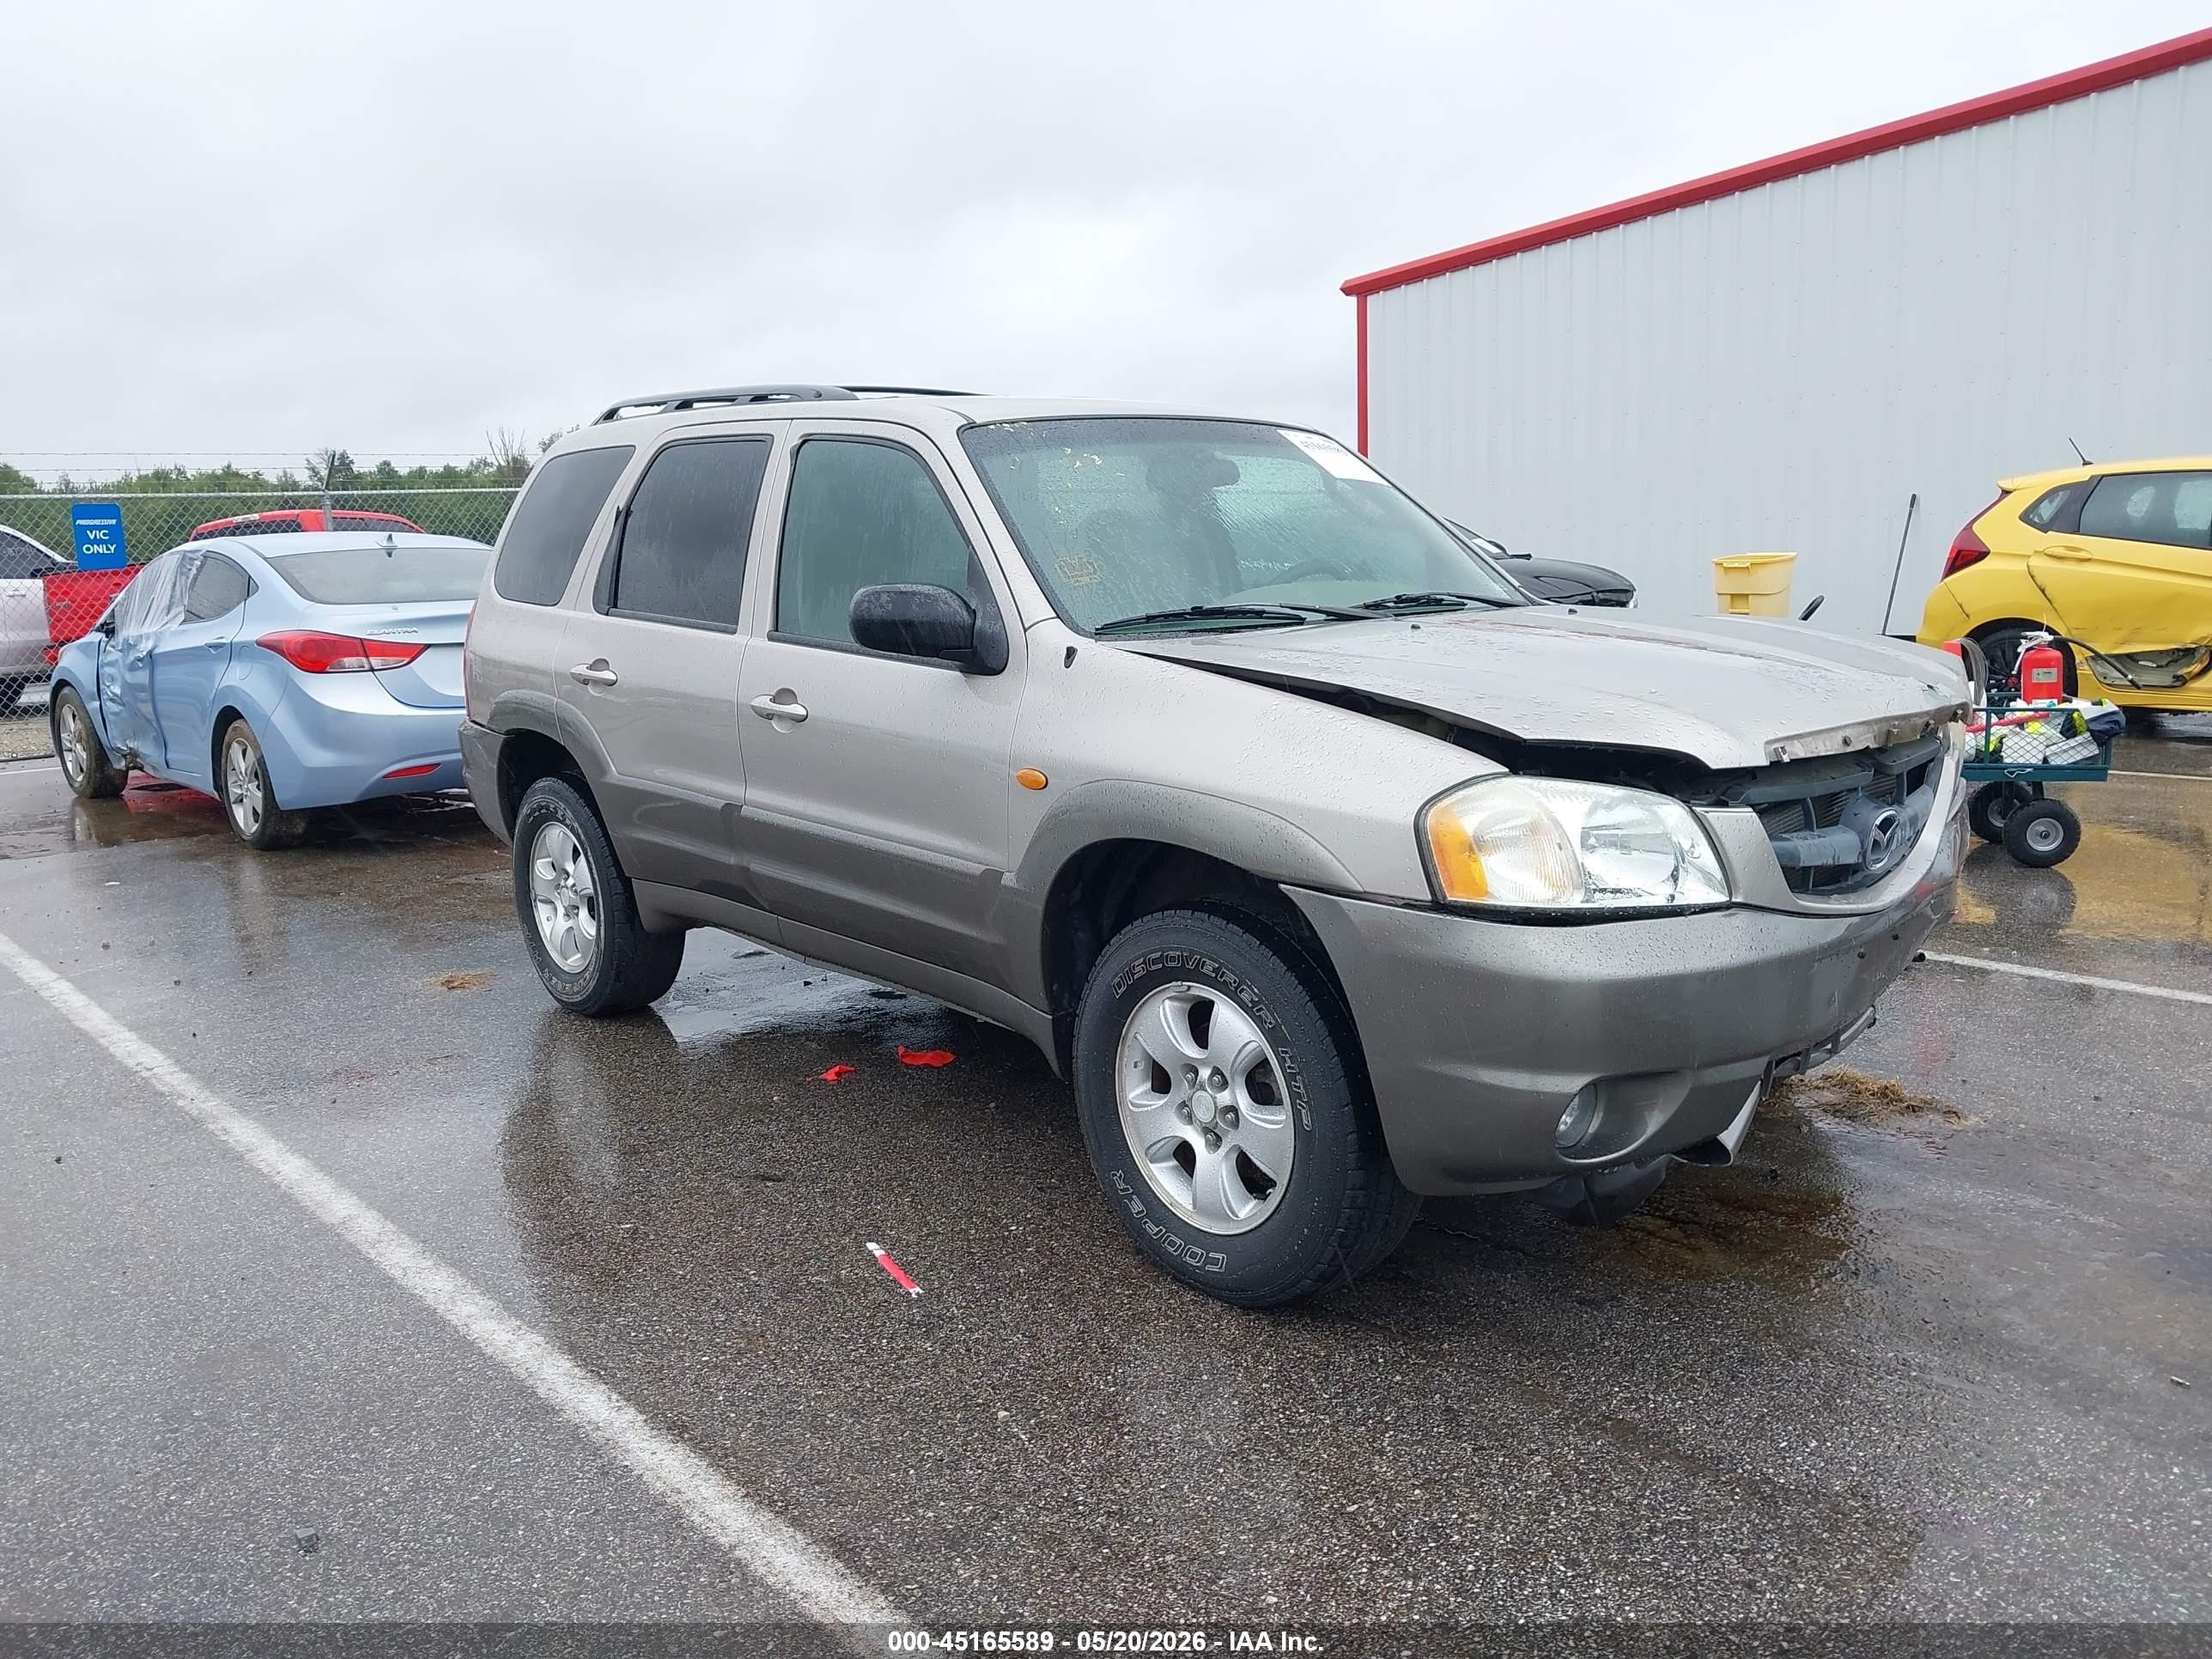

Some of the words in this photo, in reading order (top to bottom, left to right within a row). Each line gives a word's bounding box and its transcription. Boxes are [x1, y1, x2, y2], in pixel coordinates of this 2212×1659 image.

[82, 544, 117, 554] ONLY
[86, 529, 110, 540] VIC
[1111, 950, 1275, 1029] DISCOVERER
[1110, 1170, 1227, 1273] COOPER
